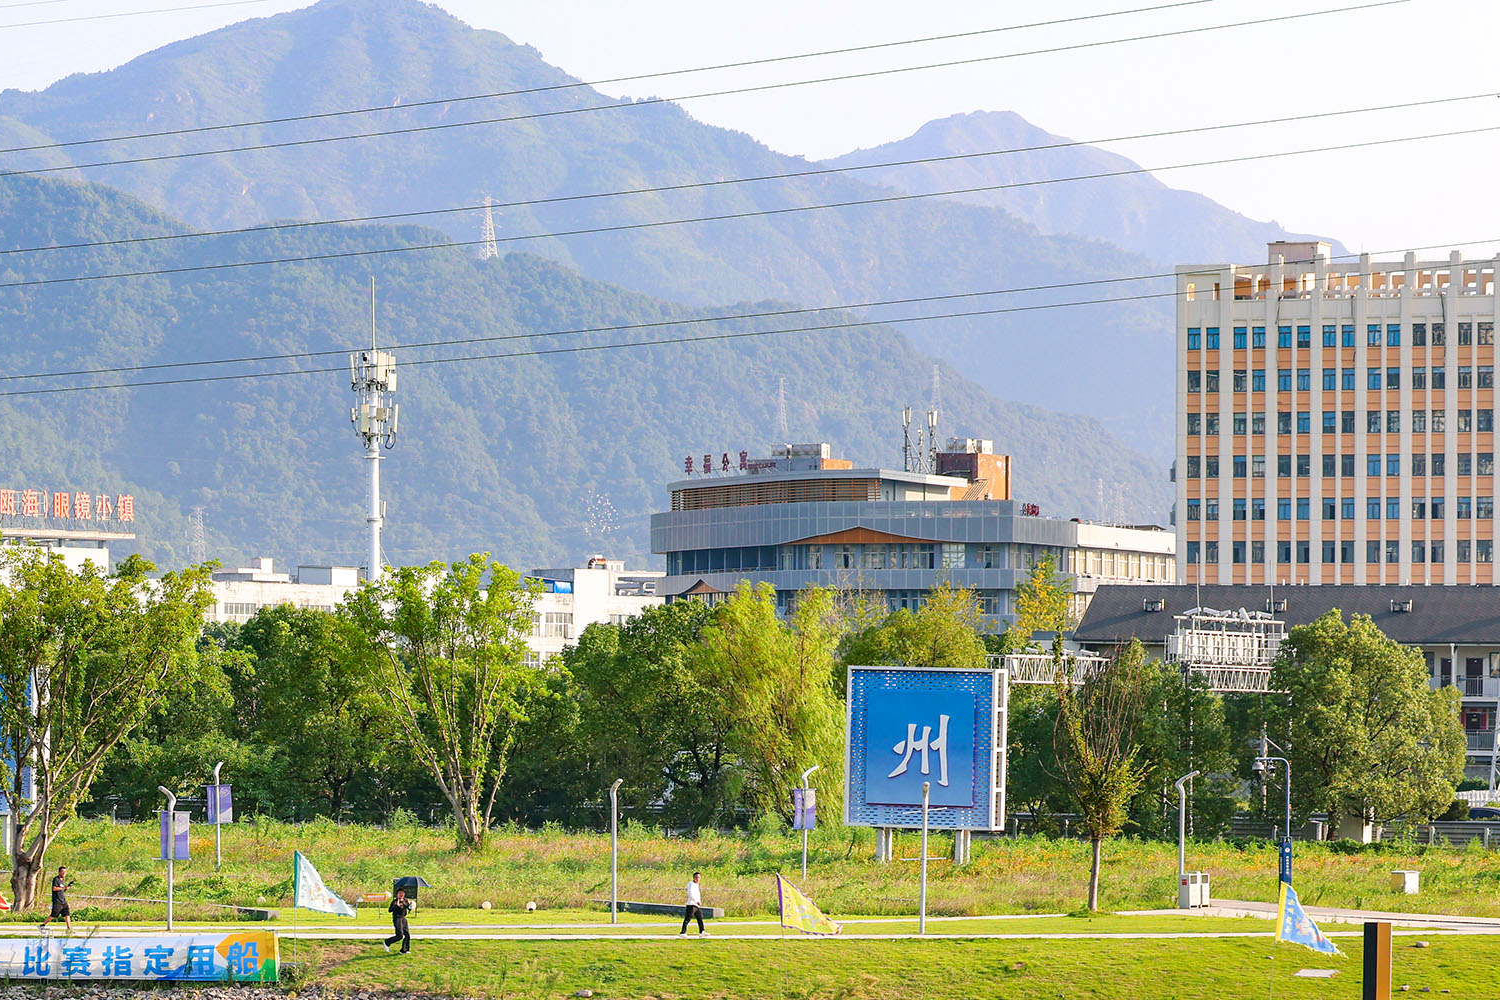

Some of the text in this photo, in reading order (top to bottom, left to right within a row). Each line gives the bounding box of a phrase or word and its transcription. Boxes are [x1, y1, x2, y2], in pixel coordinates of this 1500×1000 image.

[685, 451, 747, 475] 幸福公寓
[887, 714, 950, 787] 州
